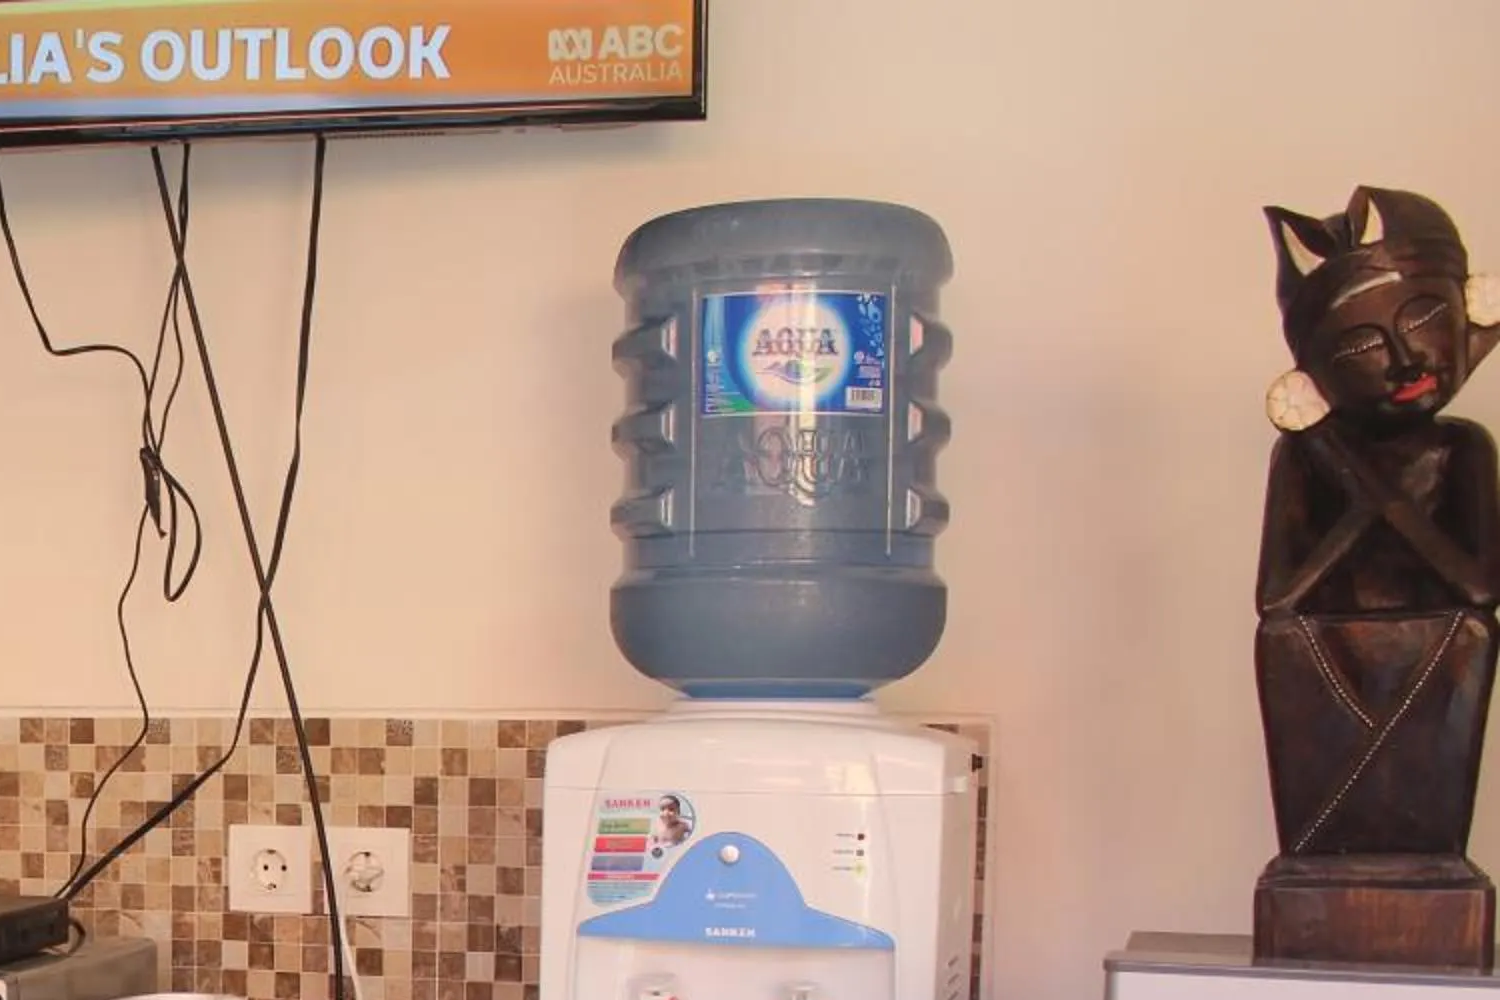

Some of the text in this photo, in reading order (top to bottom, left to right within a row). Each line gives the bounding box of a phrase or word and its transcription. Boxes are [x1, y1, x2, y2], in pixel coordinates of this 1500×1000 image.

[140, 24, 451, 82] OUTLOOK
[599, 23, 684, 60] ABC
[548, 60, 683, 86] AUSTRALIA
[751, 327, 839, 358] AQUA
[705, 926, 756, 938] SANKEN
